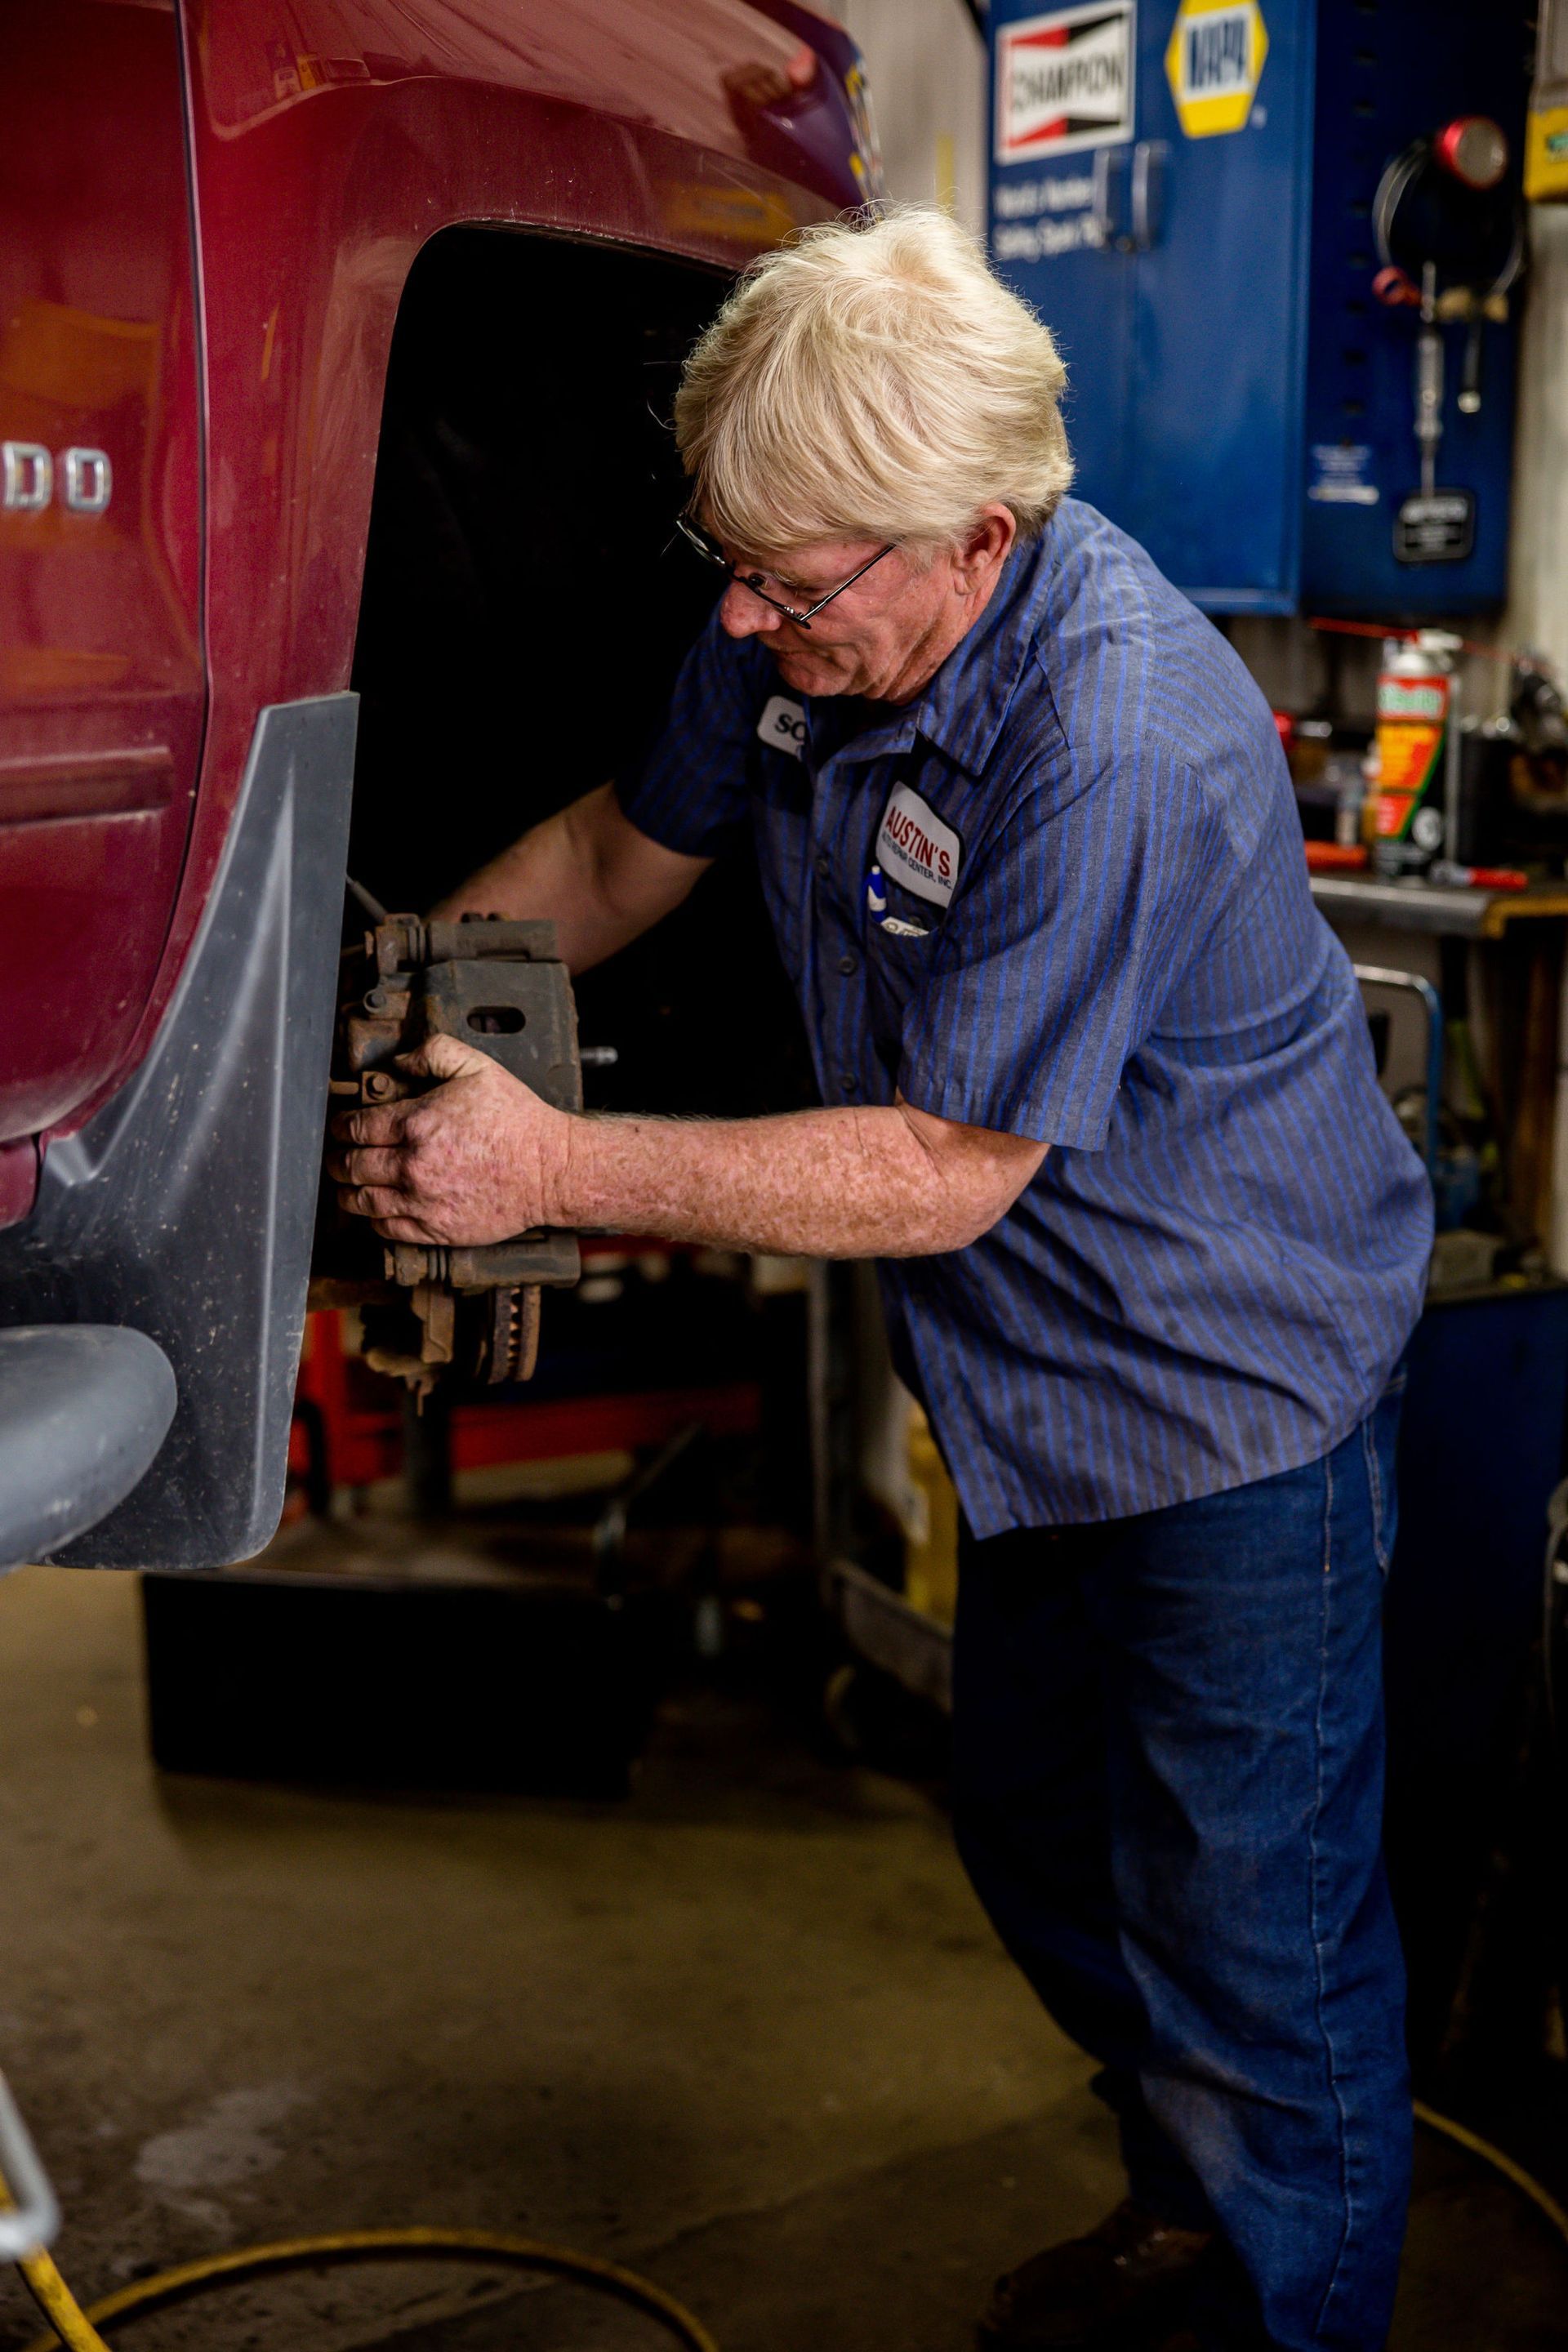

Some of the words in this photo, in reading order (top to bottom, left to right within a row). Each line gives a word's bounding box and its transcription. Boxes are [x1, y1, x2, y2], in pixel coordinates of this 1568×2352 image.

[1012, 51, 1124, 113] CHAMPION
[2, 440, 113, 511] DO
[886, 805, 951, 877] AUSTIN'S
